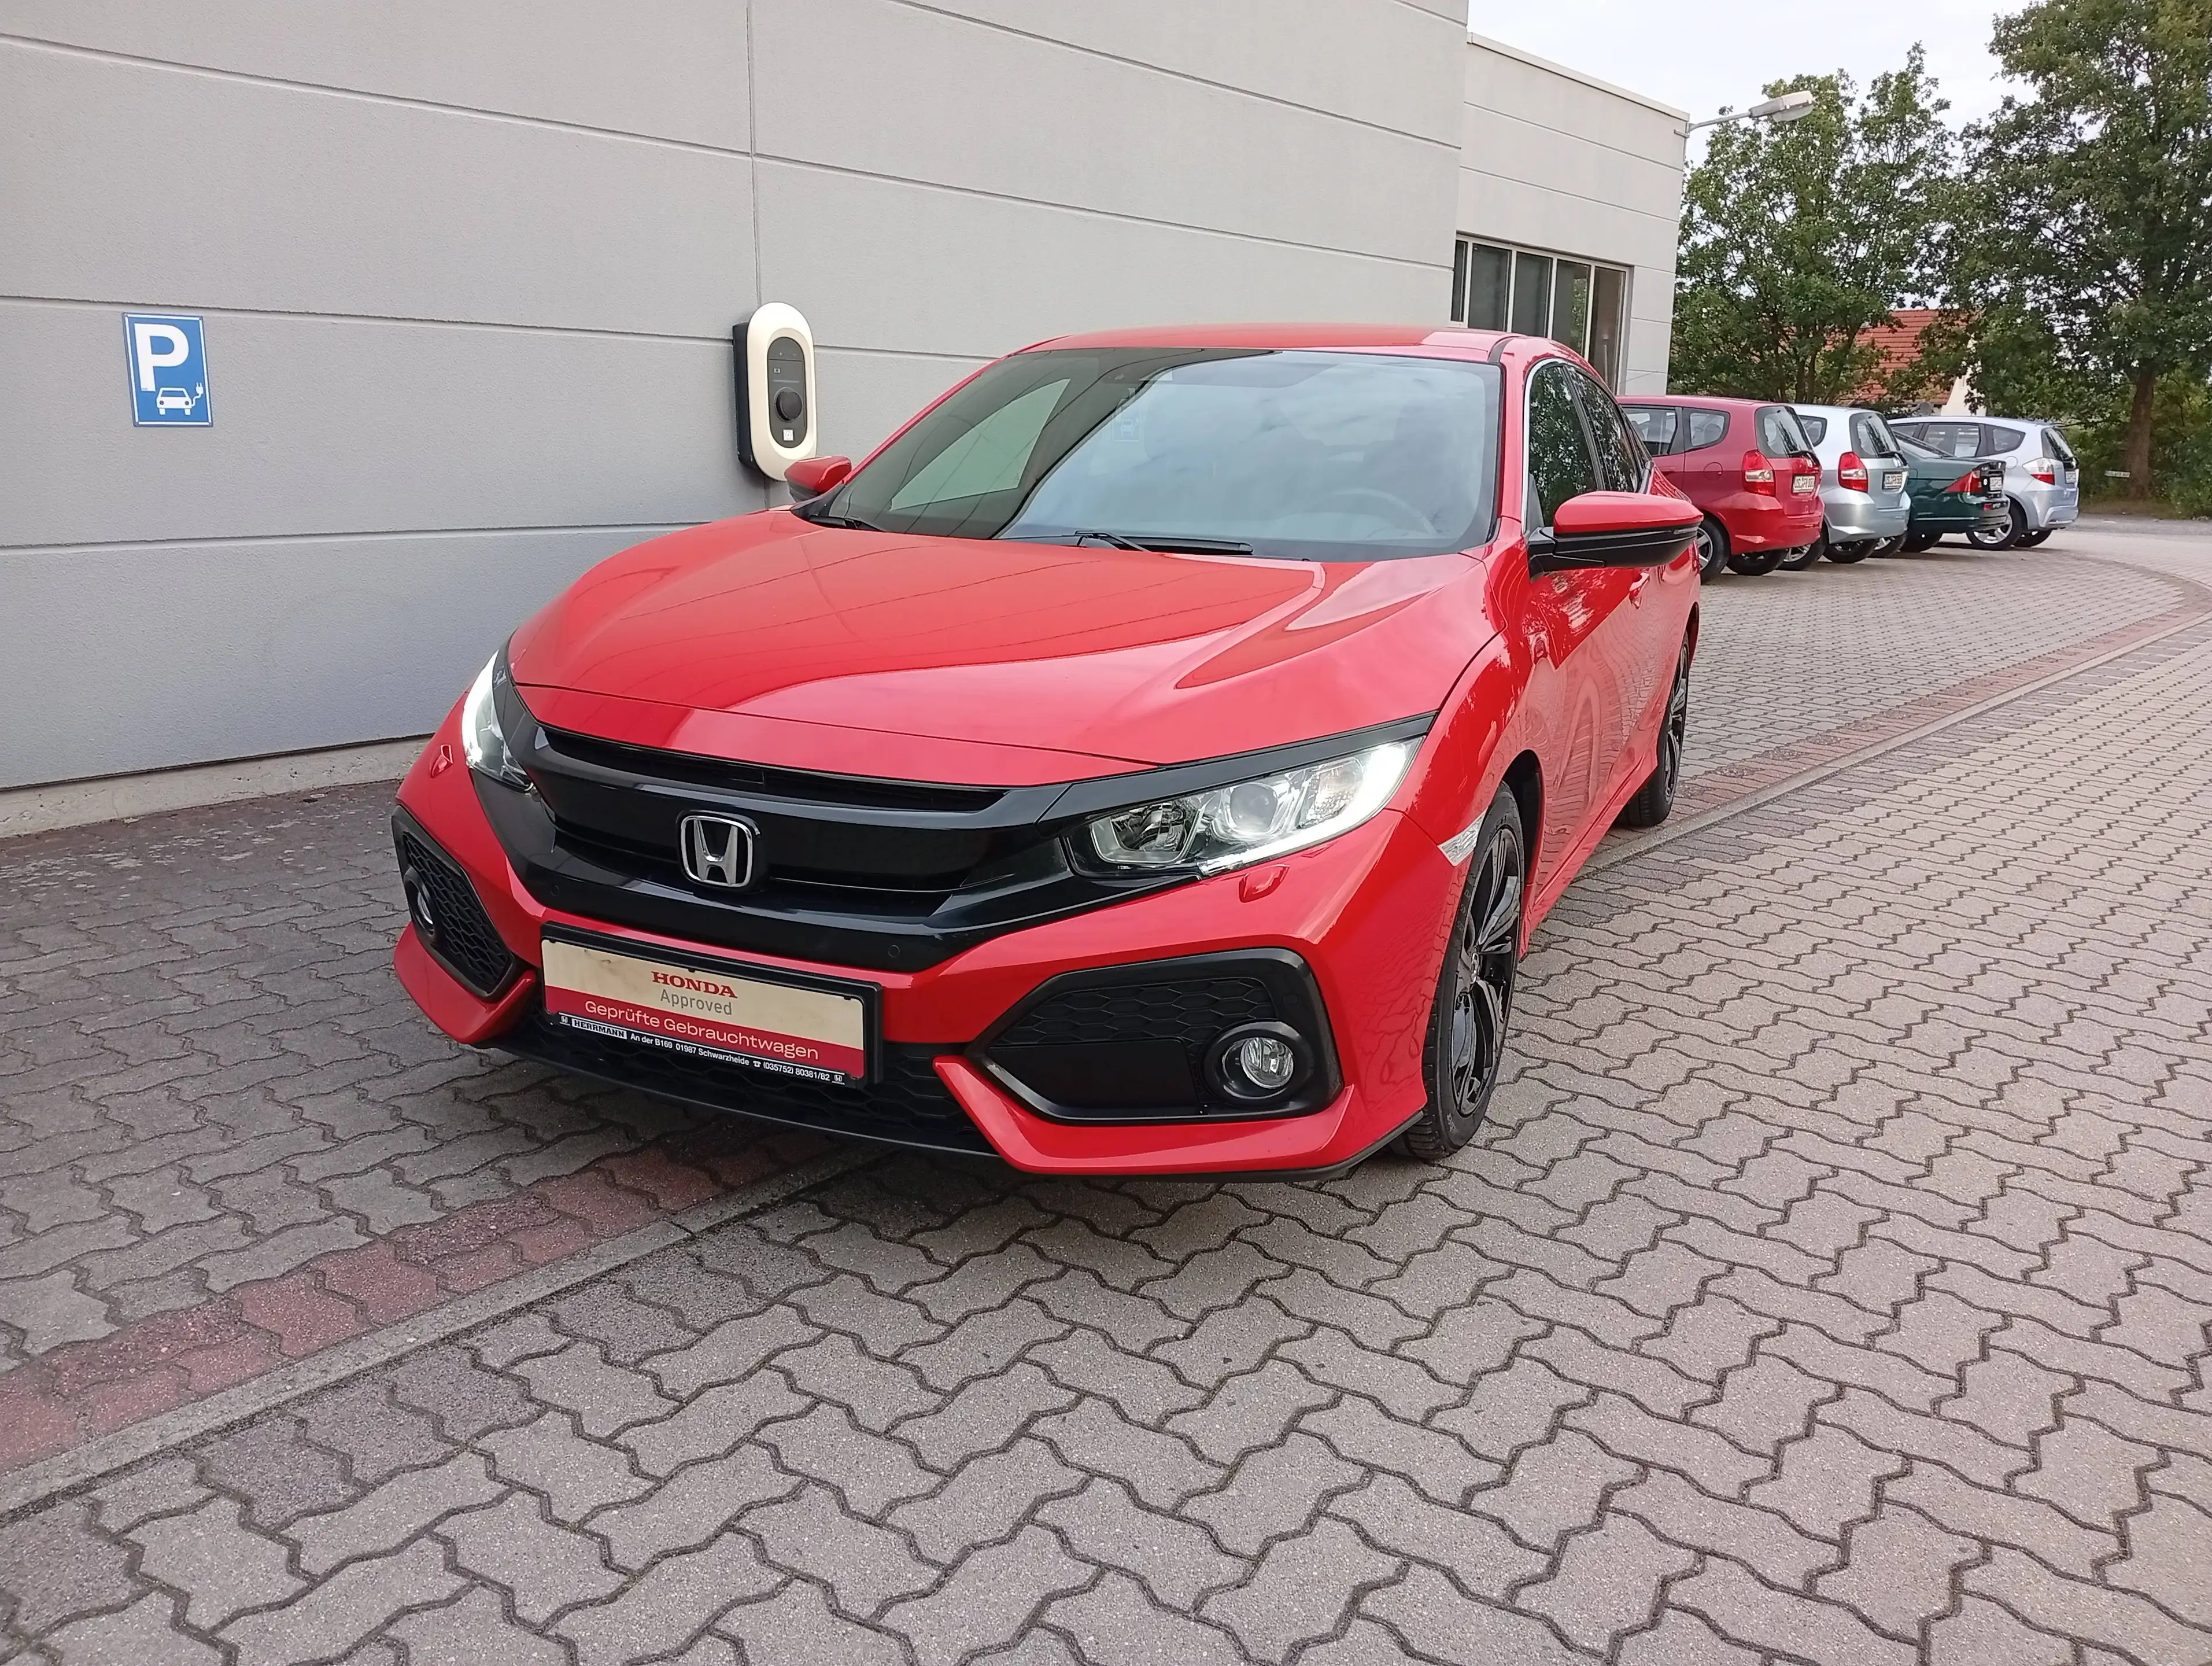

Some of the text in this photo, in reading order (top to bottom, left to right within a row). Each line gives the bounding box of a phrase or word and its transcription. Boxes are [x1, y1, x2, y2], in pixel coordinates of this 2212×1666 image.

[134, 323, 189, 392] P
[651, 971, 738, 999] HONDA
[660, 989, 733, 1016] Approved
[574, 1019, 830, 1081] HERRMANN An der B169 01987 Schwarzheide (035752) 80381/82
[585, 1000, 819, 1060] Geprüfte Gebrauchtwagen
